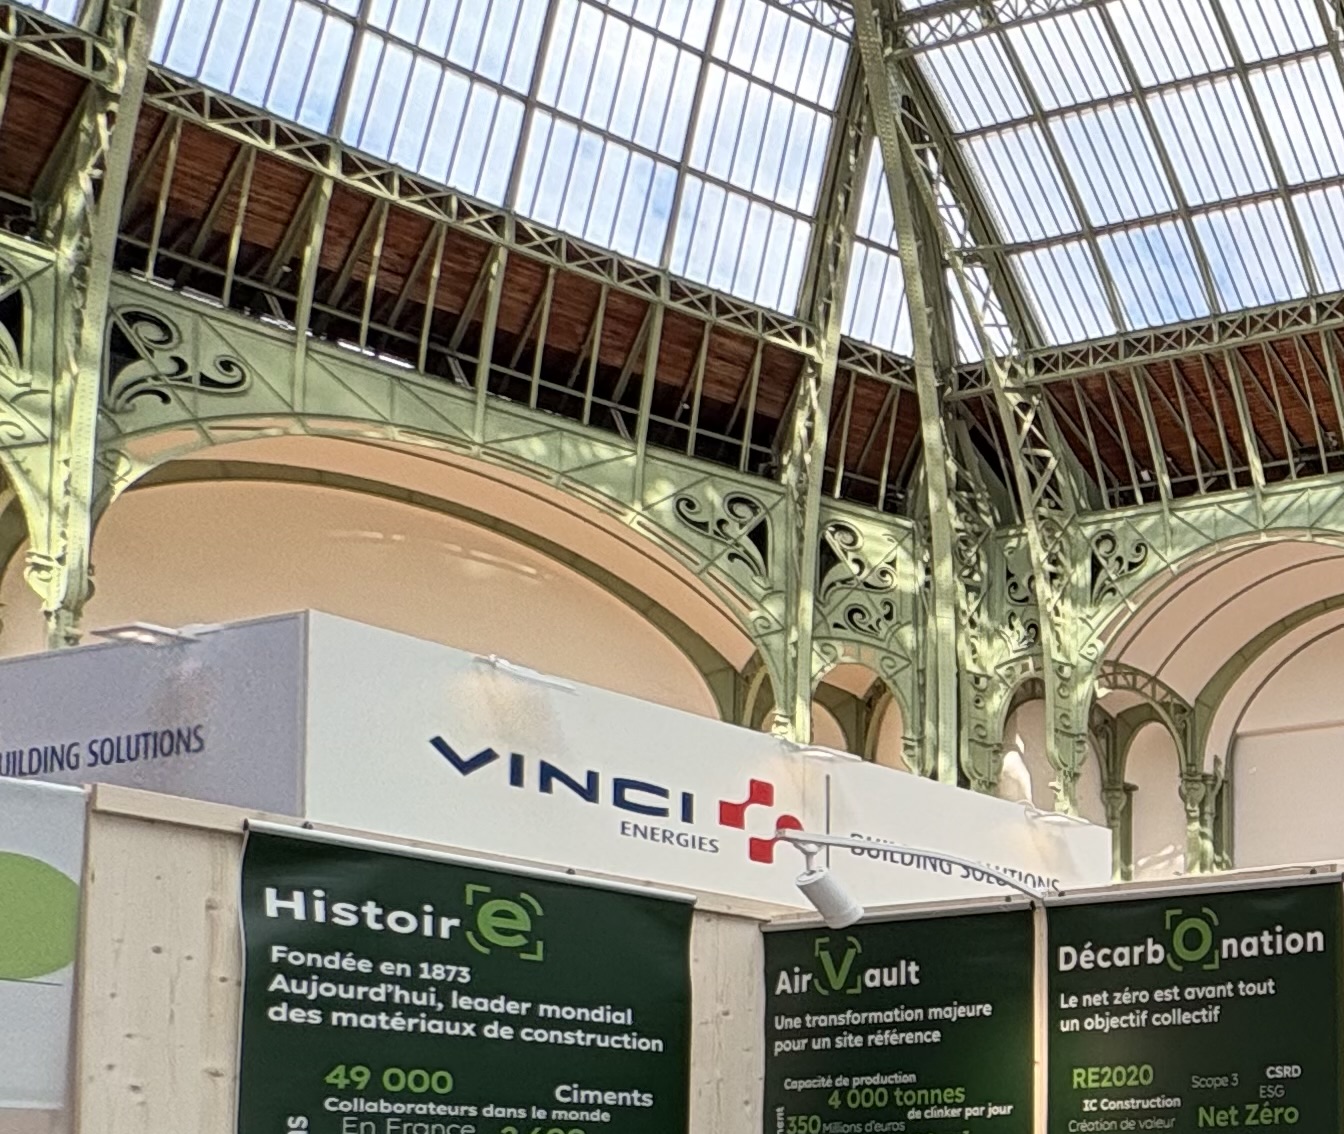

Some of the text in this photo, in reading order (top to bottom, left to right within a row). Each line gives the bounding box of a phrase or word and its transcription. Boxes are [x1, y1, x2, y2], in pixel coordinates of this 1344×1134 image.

[0, 725, 204, 776] UILDING SOLUTIONS
[429, 735, 695, 824] VINCI
[620, 820, 719, 854] ENERGIES
[271, 945, 471, 984] Fondée en 1873
[451, 989, 532, 1015] leader
[538, 1002, 633, 1025] mondial
[1060, 978, 1276, 1009] Le net zéro est avant tout
[268, 1003, 664, 1053] des matériaux de construction
[774, 1002, 992, 1030] Une transformation majeure
[1060, 1005, 1221, 1033] un objectif collectif
[774, 1028, 942, 1056] pour un site référence
[324, 1064, 454, 1095] 49 000
[784, 1071, 917, 1092] Capacité production
[1072, 1064, 1154, 1089] RE2020
[1266, 1065, 1301, 1079] CSRD
[554, 1083, 654, 1108] Ciments
[828, 1086, 966, 1109] 4 000 tonnes
[1100, 1095, 1181, 1111] Construction
[1259, 1085, 1286, 1099] ESG
[324, 1098, 611, 1123] Collaborateurs dans le monde
[987, 1102, 1013, 1118] jour
[1198, 1101, 1299, 1128] Net Zéro
